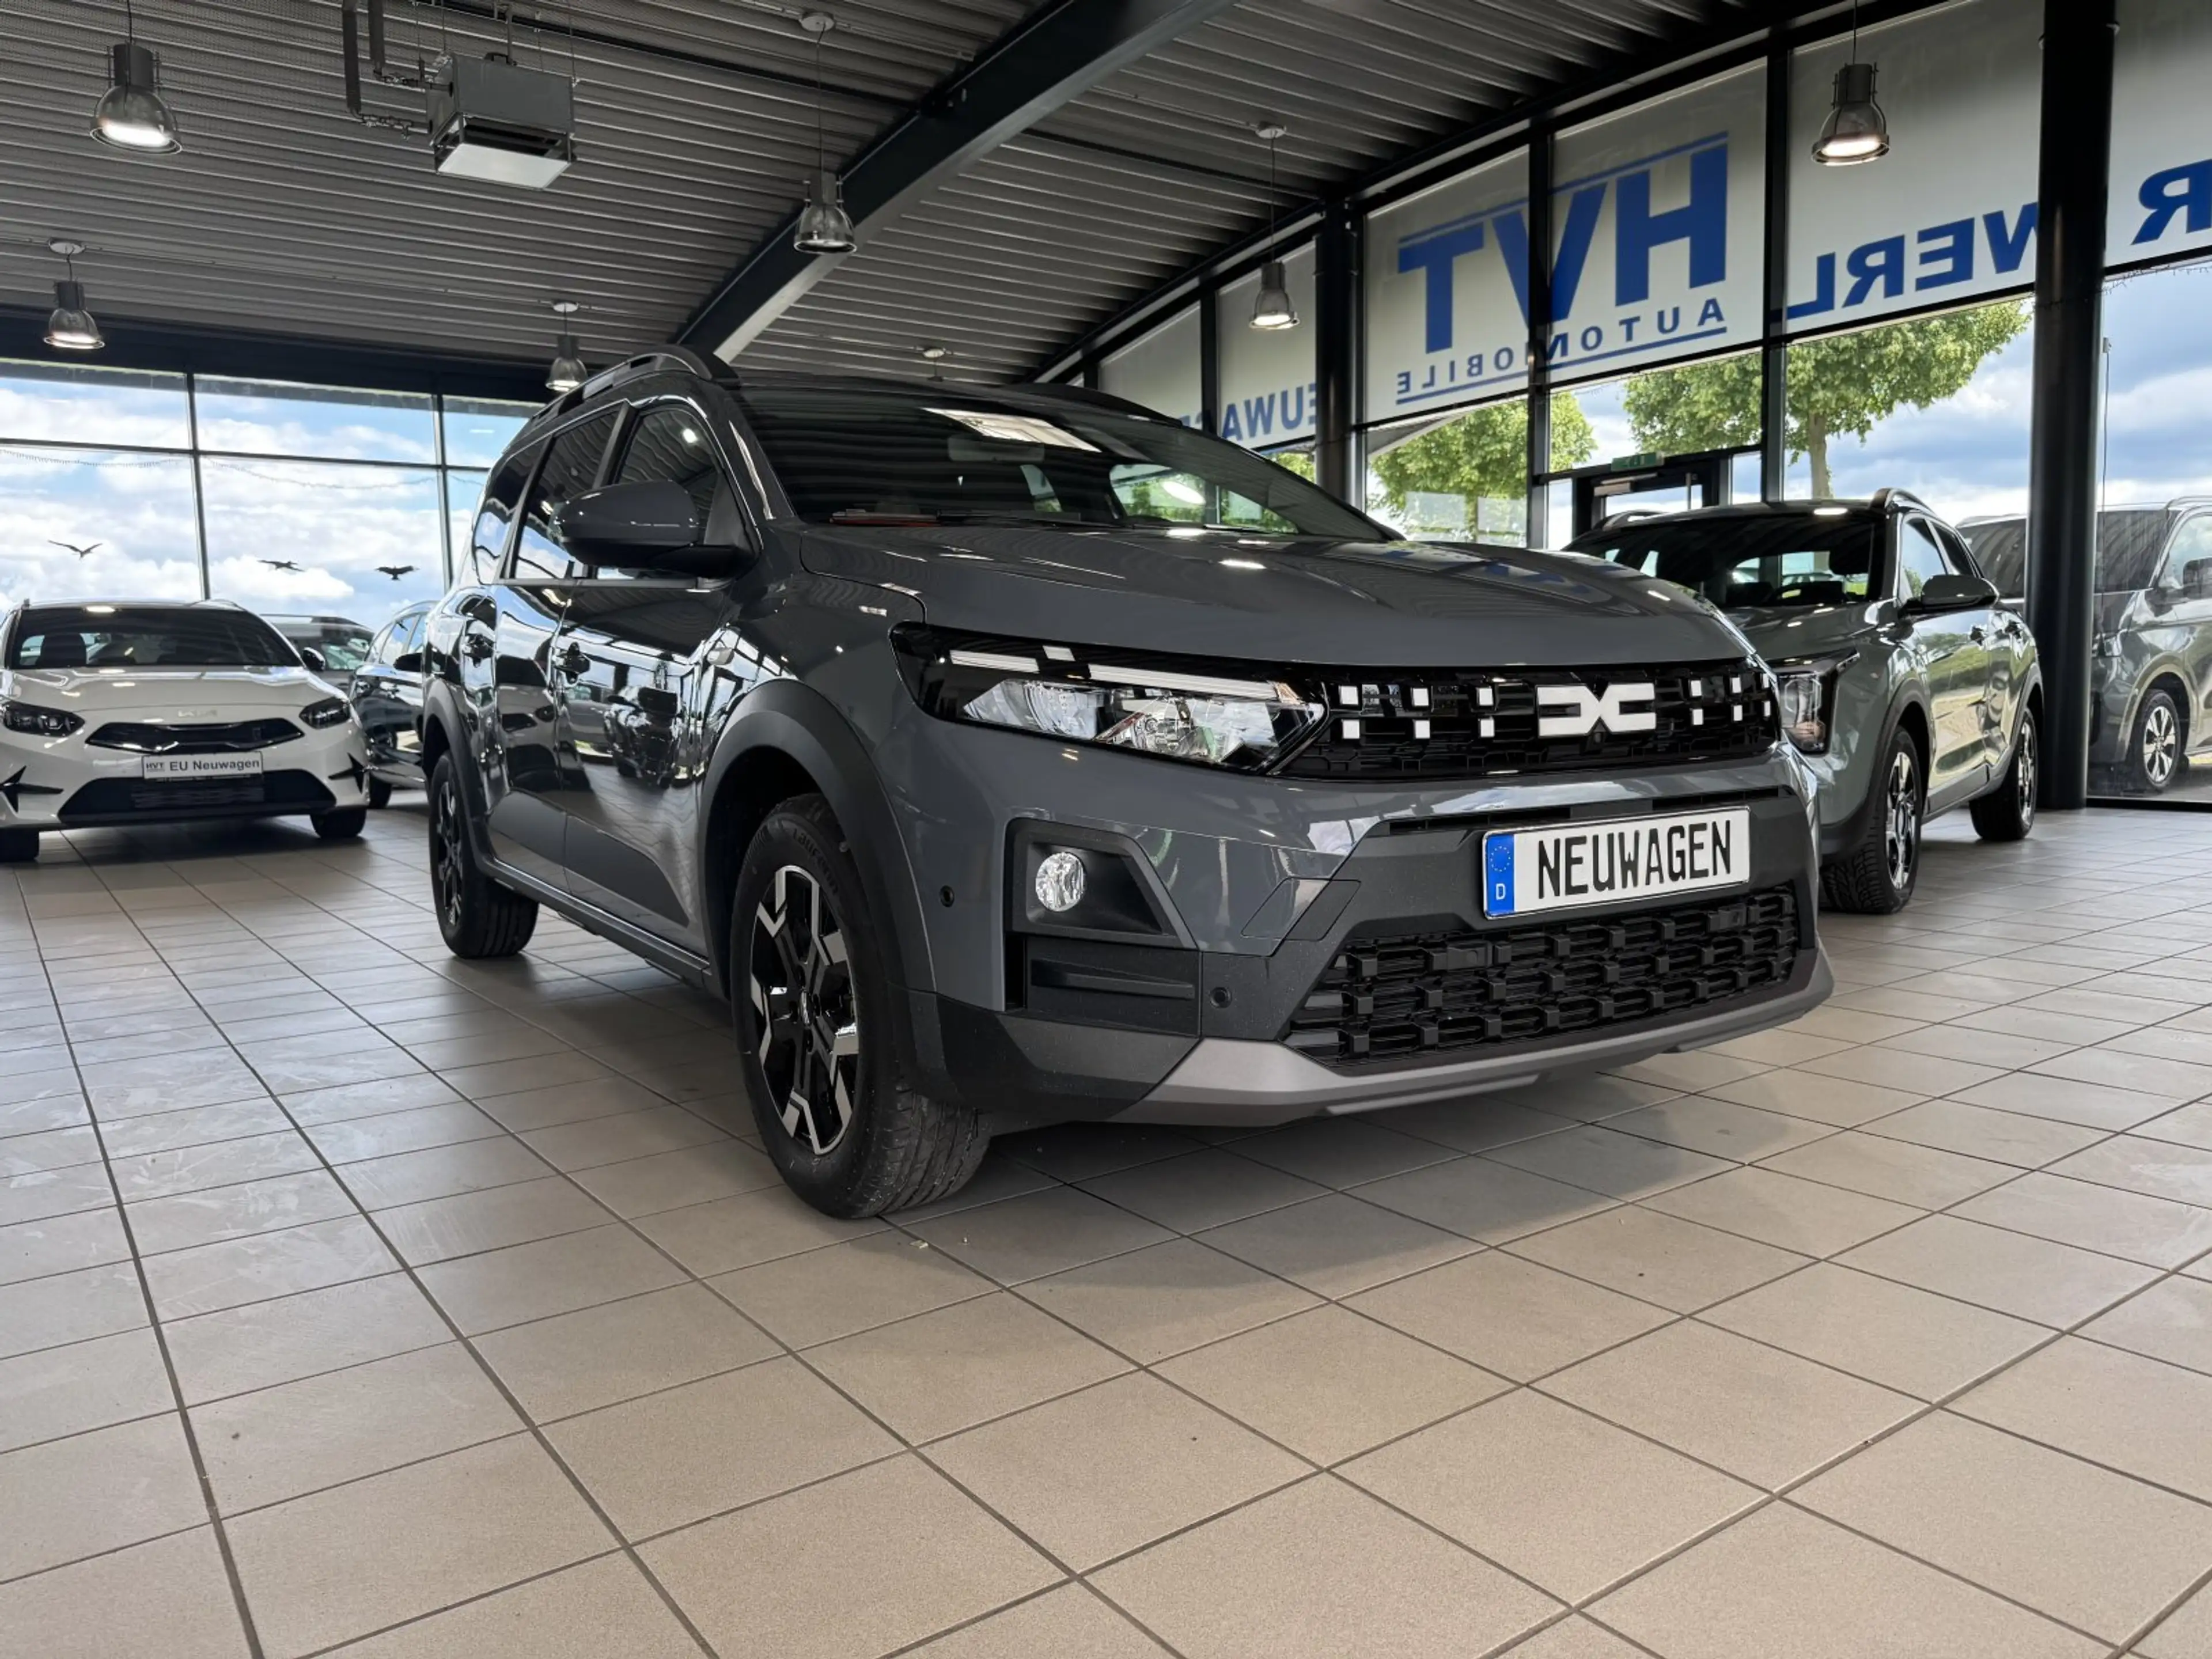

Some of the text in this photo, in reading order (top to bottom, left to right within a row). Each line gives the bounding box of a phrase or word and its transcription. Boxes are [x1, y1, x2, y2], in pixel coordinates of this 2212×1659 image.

[169, 761, 188, 771] EU
[193, 759, 260, 771] Neuwagen
[1537, 820, 1732, 900] NEUWAGEN
[1495, 882, 1506, 900] D
